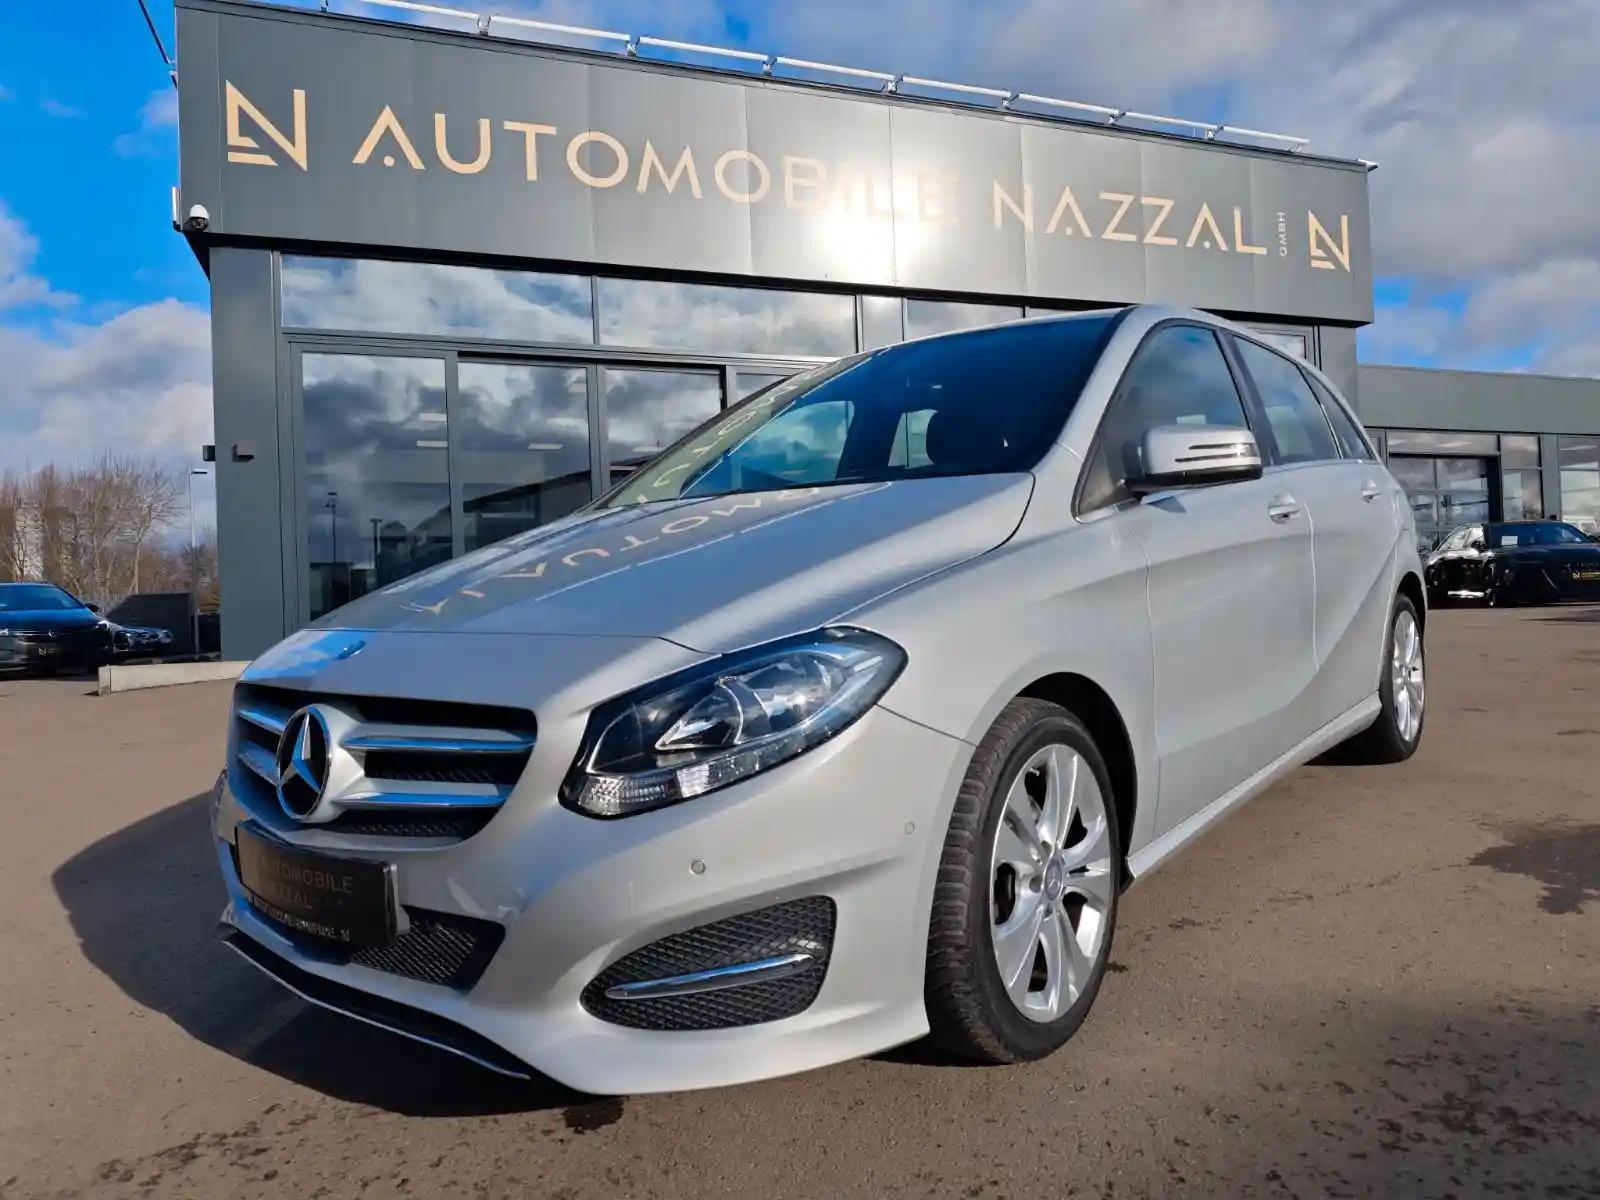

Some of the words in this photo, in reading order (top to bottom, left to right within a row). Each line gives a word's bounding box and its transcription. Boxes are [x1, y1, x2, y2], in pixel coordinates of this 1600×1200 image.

[352, 105, 959, 226] AUTOMOBILE
[993, 179, 1268, 256] NAZZAL
[1277, 211, 1288, 257] GMBH
